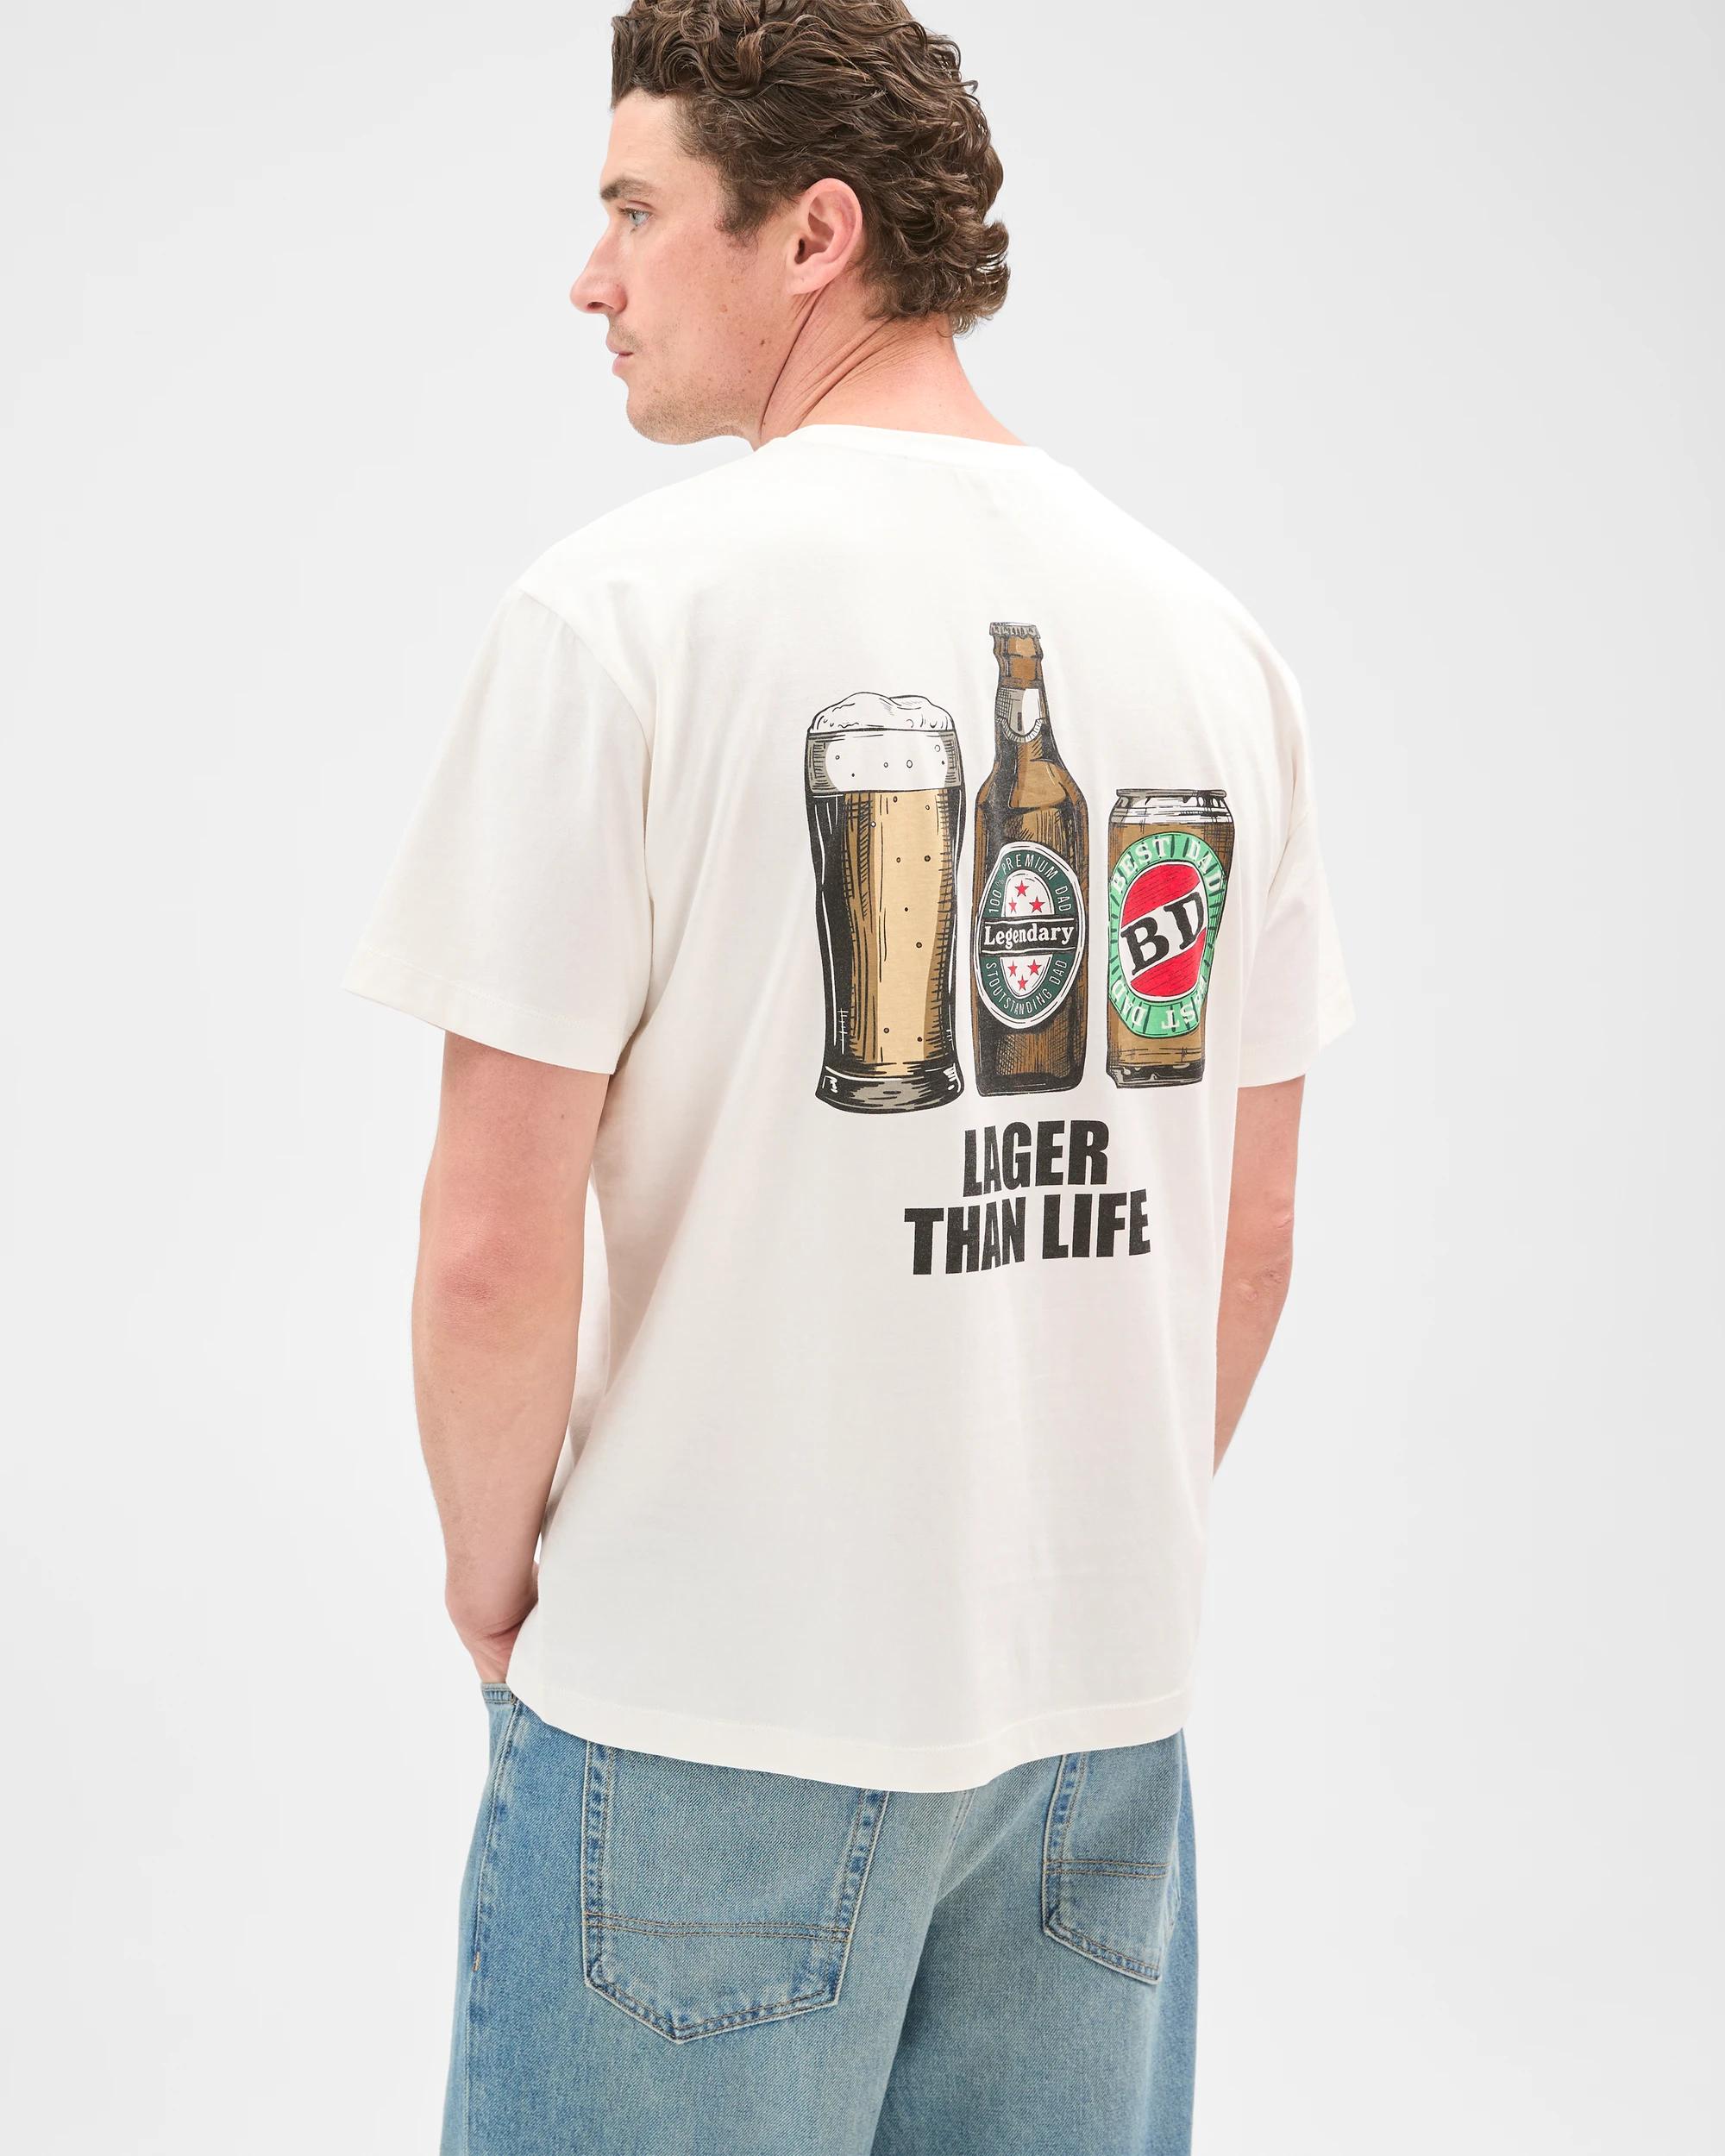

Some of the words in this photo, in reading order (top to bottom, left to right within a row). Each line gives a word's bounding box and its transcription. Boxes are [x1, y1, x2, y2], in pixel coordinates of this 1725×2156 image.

[1001, 853, 1059, 881] PREMIUM
[1055, 885, 1072, 912] DAD
[1112, 836, 1170, 894] BEST
[1186, 839, 1223, 892] DAD
[983, 922, 1075, 950] Legendary
[1120, 891, 1205, 976] BD
[986, 962, 1053, 1015] STOUTSTANDING
[1048, 960, 1068, 985] DAD
[1111, 978, 1147, 1028] DAD
[963, 1119, 1110, 1198] LAGER
[904, 1196, 1026, 1275] THAN
[1042, 1188, 1151, 1259] LIFE
